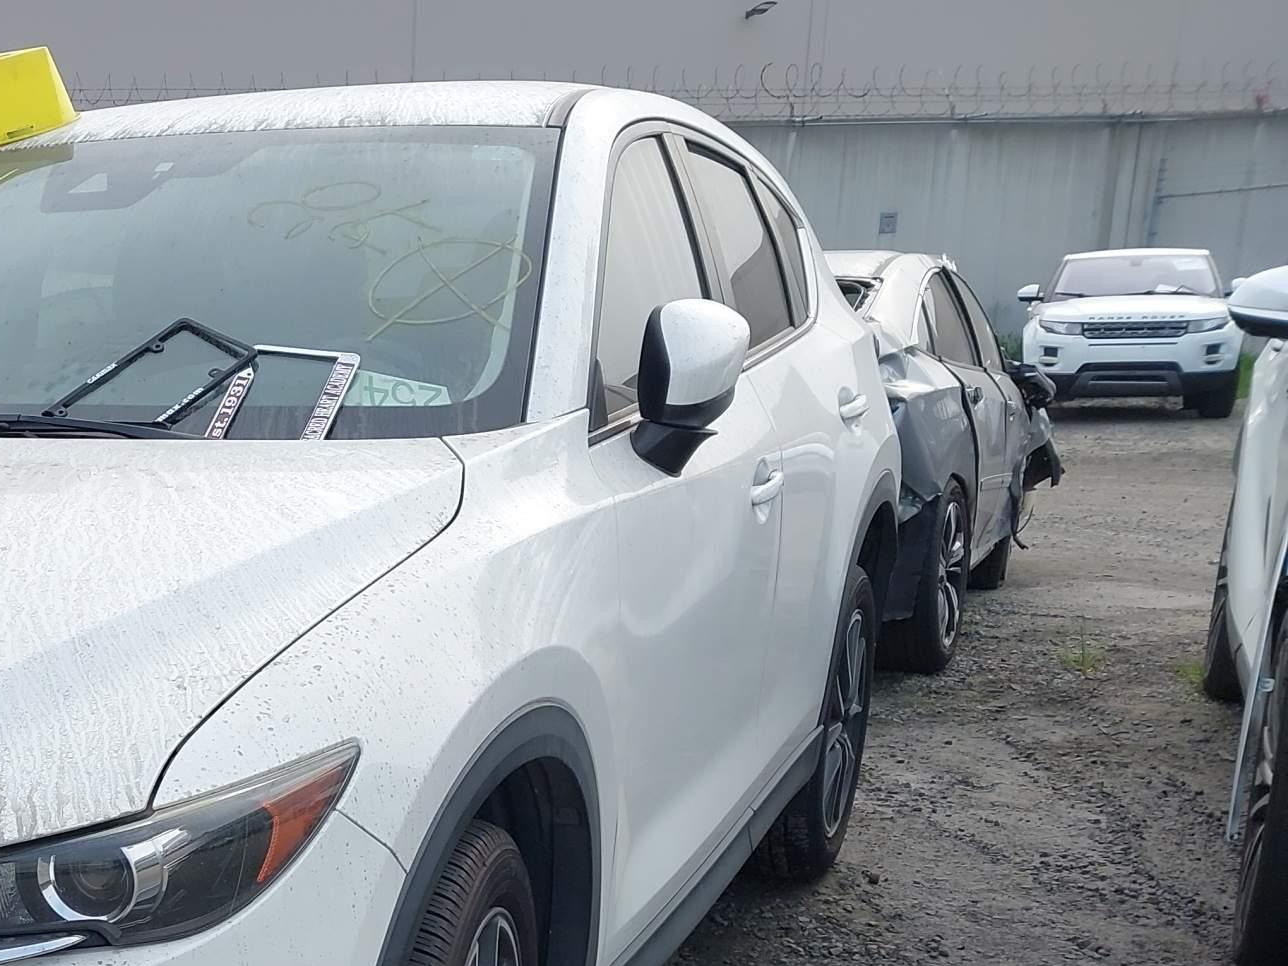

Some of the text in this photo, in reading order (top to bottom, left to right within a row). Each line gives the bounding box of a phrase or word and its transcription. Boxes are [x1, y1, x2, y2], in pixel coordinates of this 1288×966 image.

[324, 363, 353, 395] ACADEMY
[156, 387, 204, 422] max.com
[213, 376, 248, 437] st. 1931
[315, 393, 339, 419] HEART
